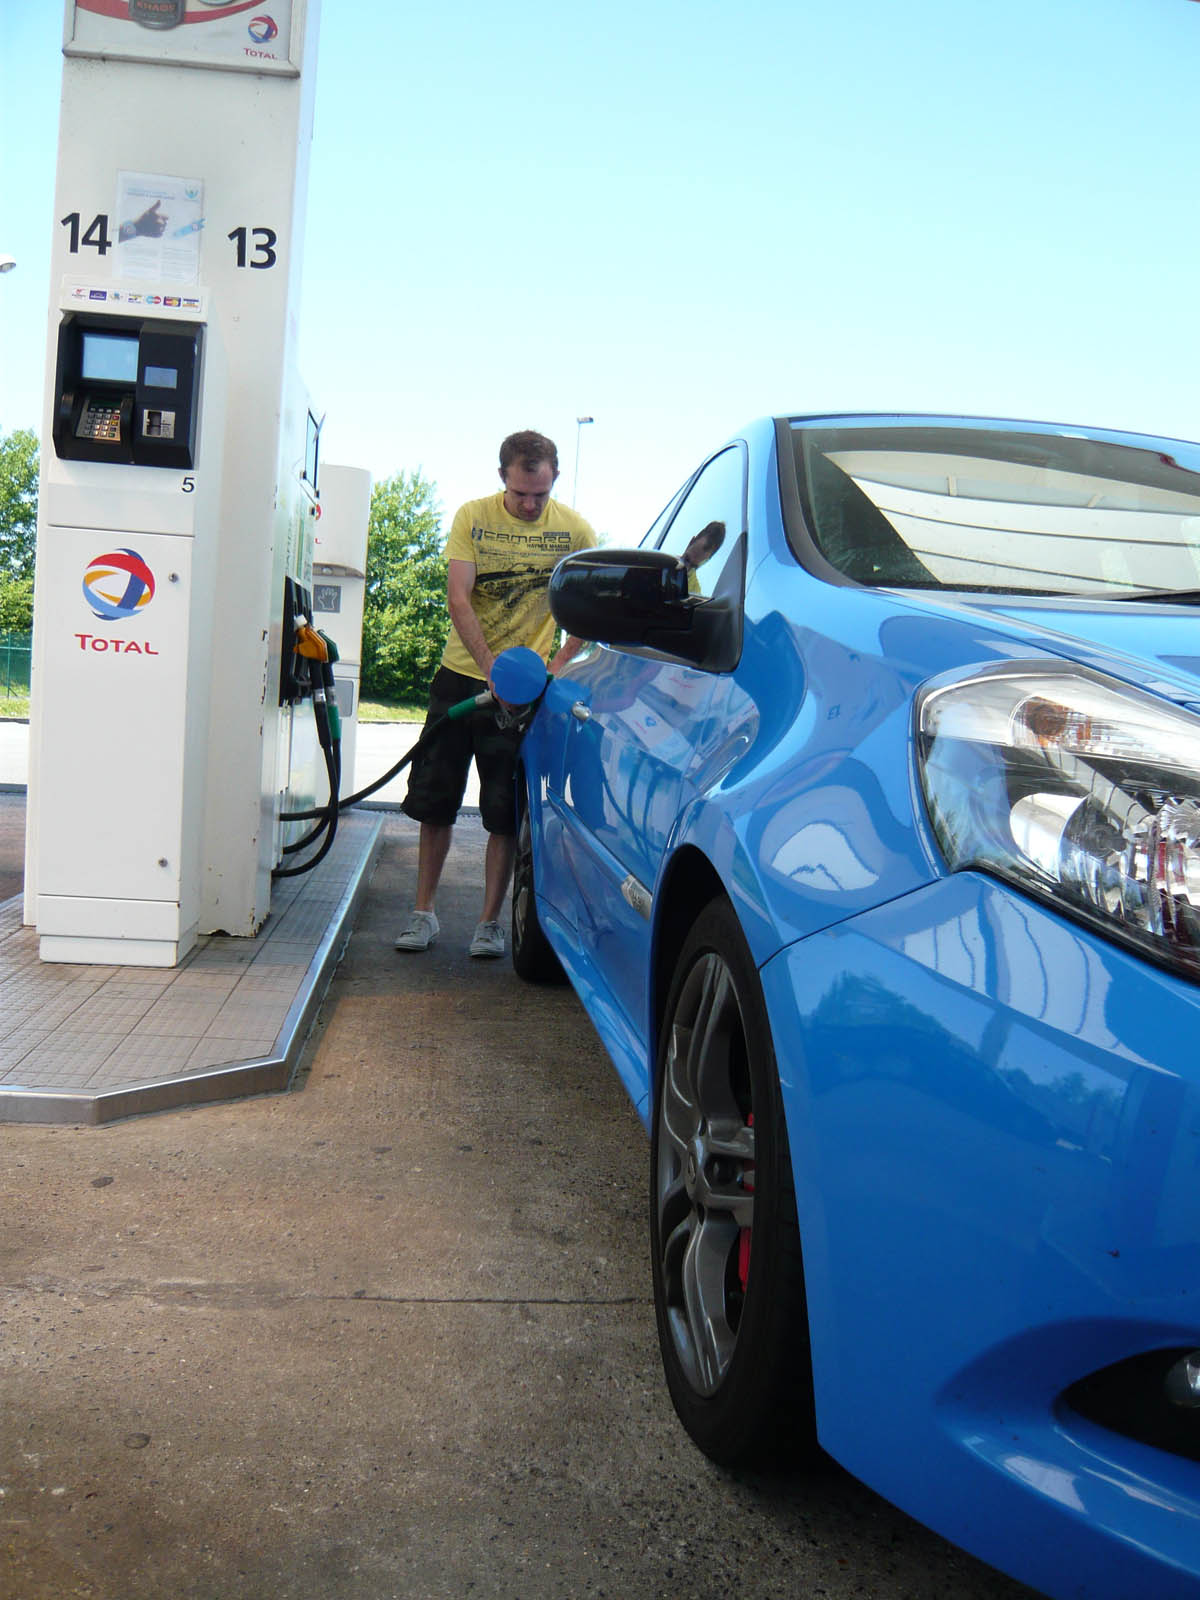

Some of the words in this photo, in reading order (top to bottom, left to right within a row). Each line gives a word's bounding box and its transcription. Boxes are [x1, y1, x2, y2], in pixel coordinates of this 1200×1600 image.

[243, 47, 278, 60] TOTAL
[60, 212, 112, 256] 14
[227, 227, 277, 270] 13
[181, 477, 195, 494] 5
[74, 633, 160, 656] TOTAL
